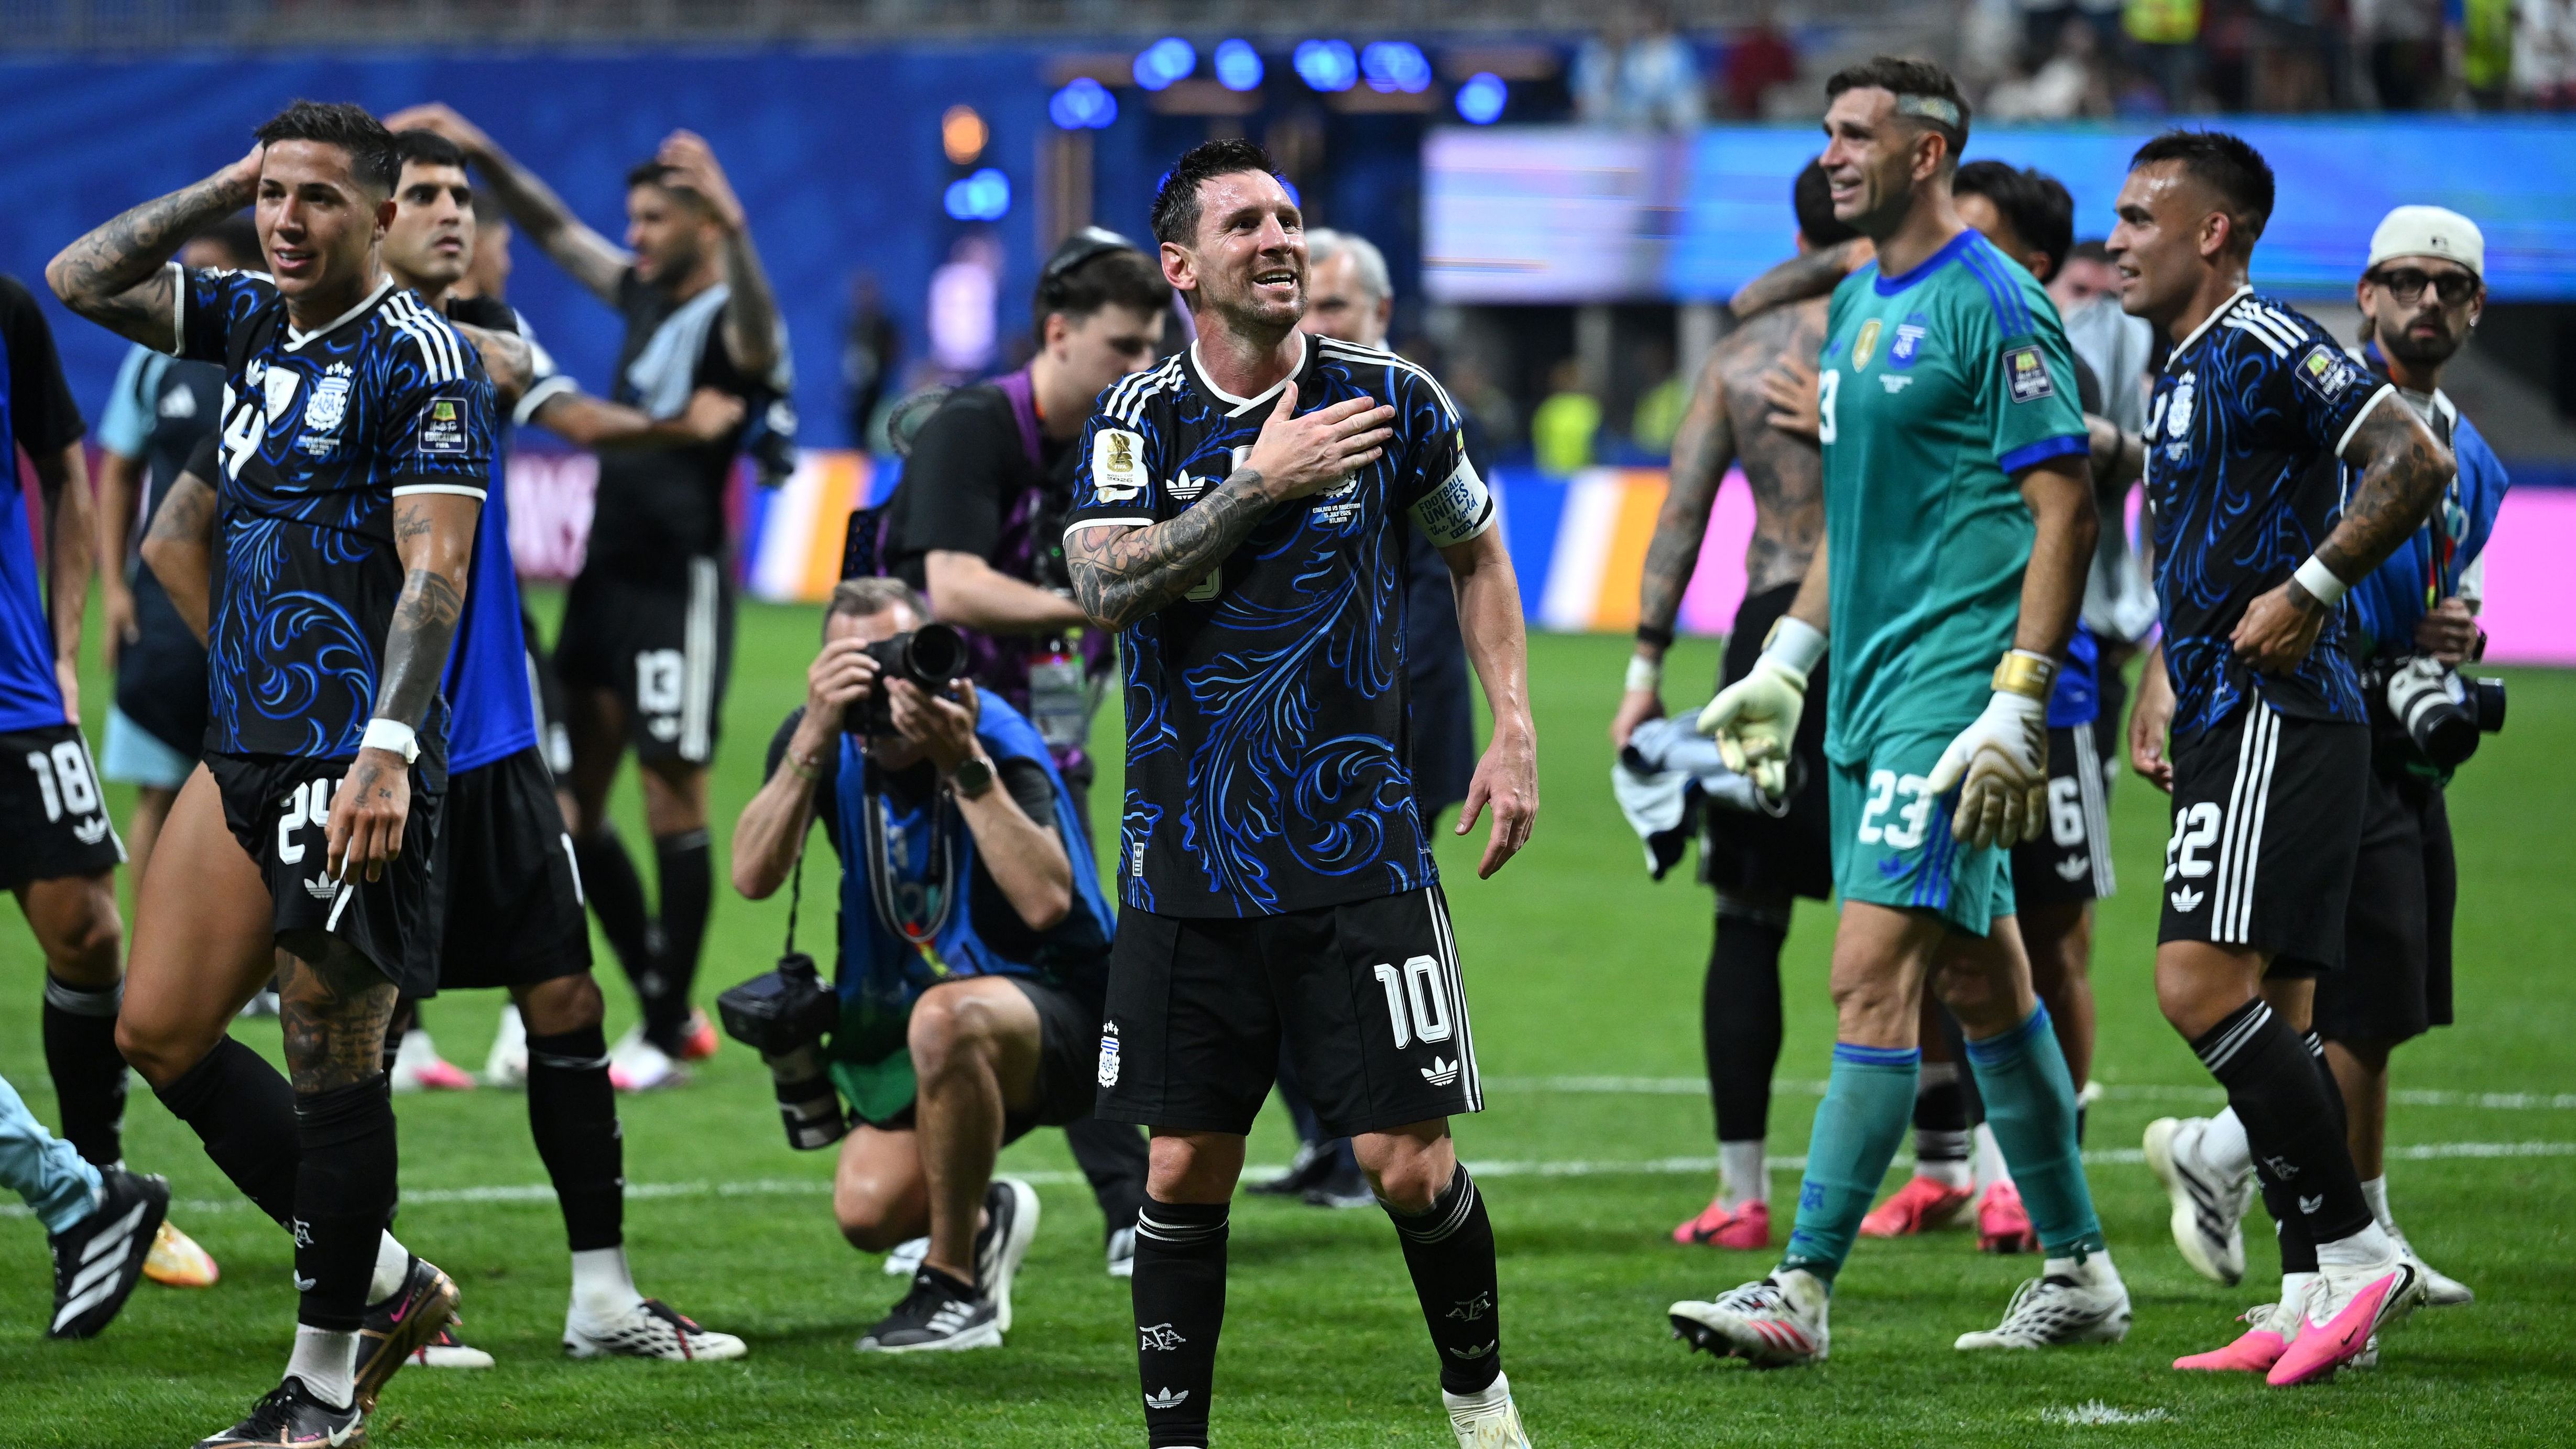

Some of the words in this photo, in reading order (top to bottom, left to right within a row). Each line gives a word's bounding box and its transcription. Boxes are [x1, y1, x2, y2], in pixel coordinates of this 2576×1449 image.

[315, 391, 335, 414] AFA
[424, 431, 461, 443] EDUCATION
[1418, 474, 1462, 513] FOOTBALL
[1422, 483, 1468, 525] UNITES
[1428, 525, 1448, 536] the
[1448, 494, 1478, 527] World
[1451, 520, 1472, 538] FIFA
[27, 739, 99, 824] 18
[1858, 769, 1935, 850] 23
[2163, 801, 2222, 885] 22
[1373, 954, 1453, 1050] 10
[1101, 1050, 1114, 1073] AFA
[292, 1214, 314, 1248] FA
[1446, 1291, 1491, 1322] AFA
[1139, 1323, 1186, 1350] AFA
